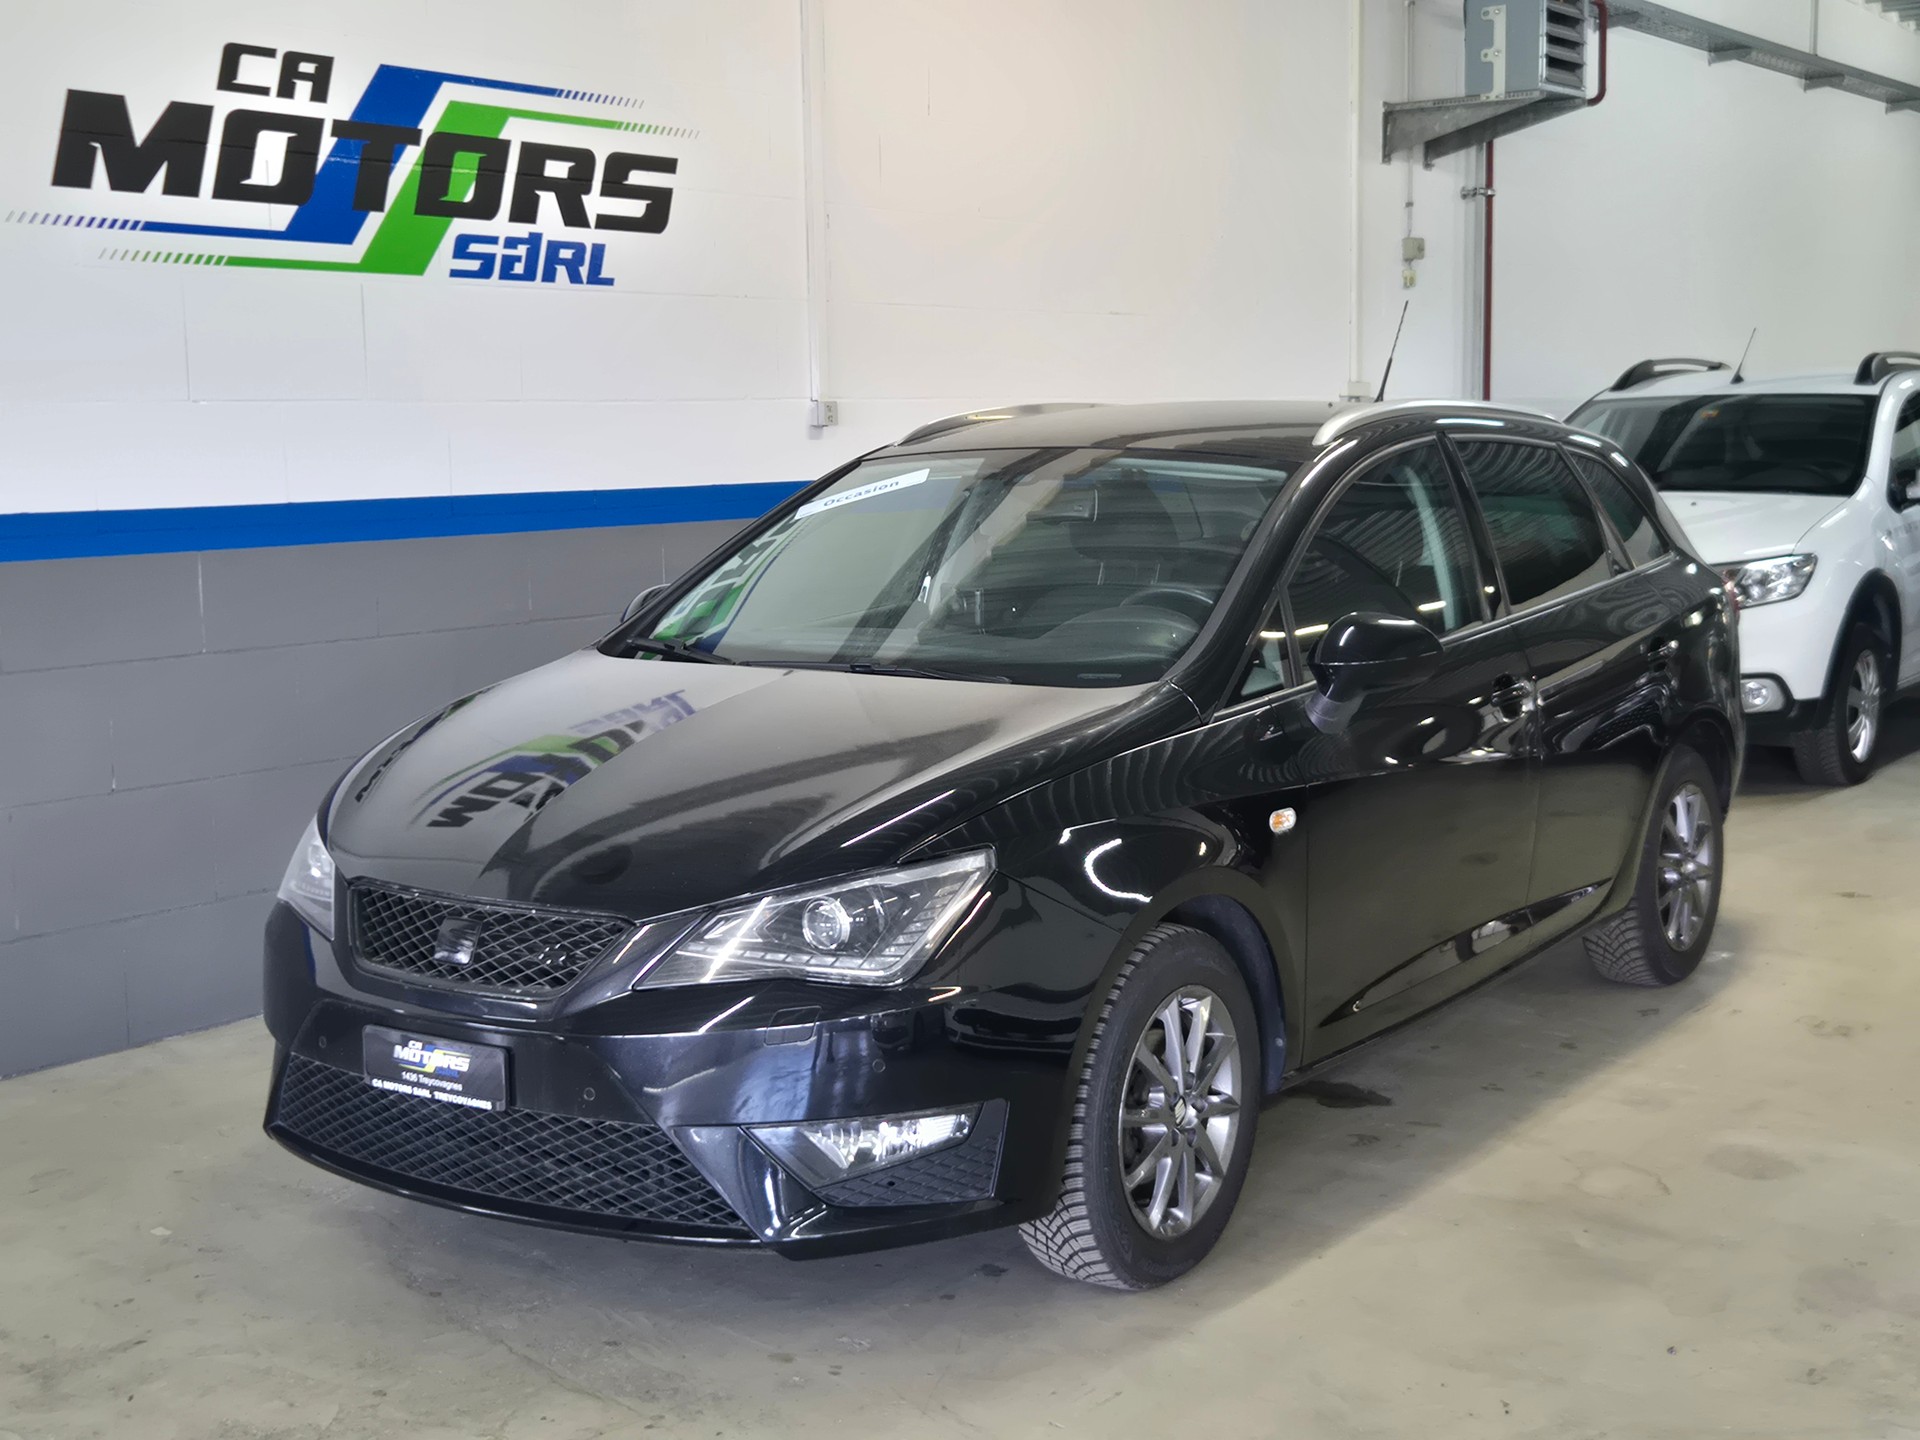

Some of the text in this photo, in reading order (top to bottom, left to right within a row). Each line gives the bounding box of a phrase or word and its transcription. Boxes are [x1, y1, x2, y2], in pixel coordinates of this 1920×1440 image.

[217, 42, 334, 104] CA
[51, 89, 678, 234] MOTORS
[823, 480, 899, 507] Occasion
[393, 1044, 471, 1072] MOTORS
